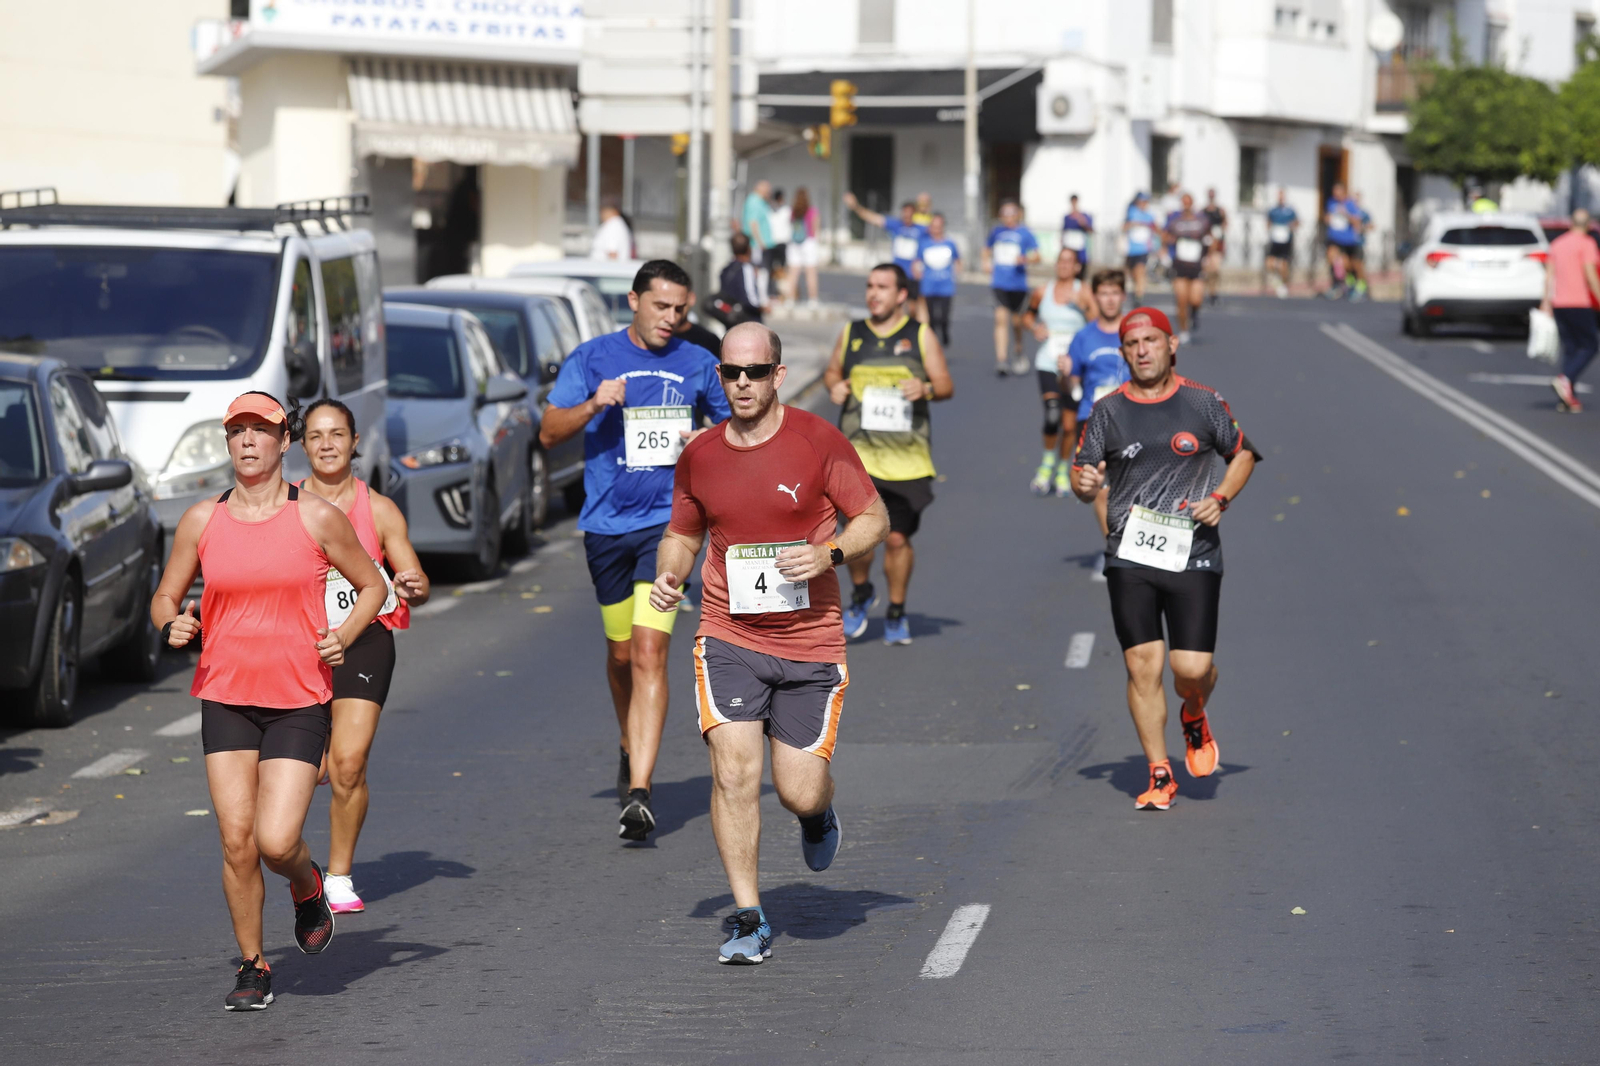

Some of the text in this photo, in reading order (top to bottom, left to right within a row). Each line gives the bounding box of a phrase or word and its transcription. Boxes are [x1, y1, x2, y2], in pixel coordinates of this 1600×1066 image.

[331, 14, 567, 40] PATATAS FRITAS
[872, 405, 896, 419] 442
[637, 431, 670, 449] 265
[731, 548, 740, 558] 34
[741, 547, 767, 558] VUELTA
[768, 546, 775, 557] A
[1135, 531, 1168, 552] 342
[755, 572, 768, 594] 4
[336, 588, 358, 610] 80
